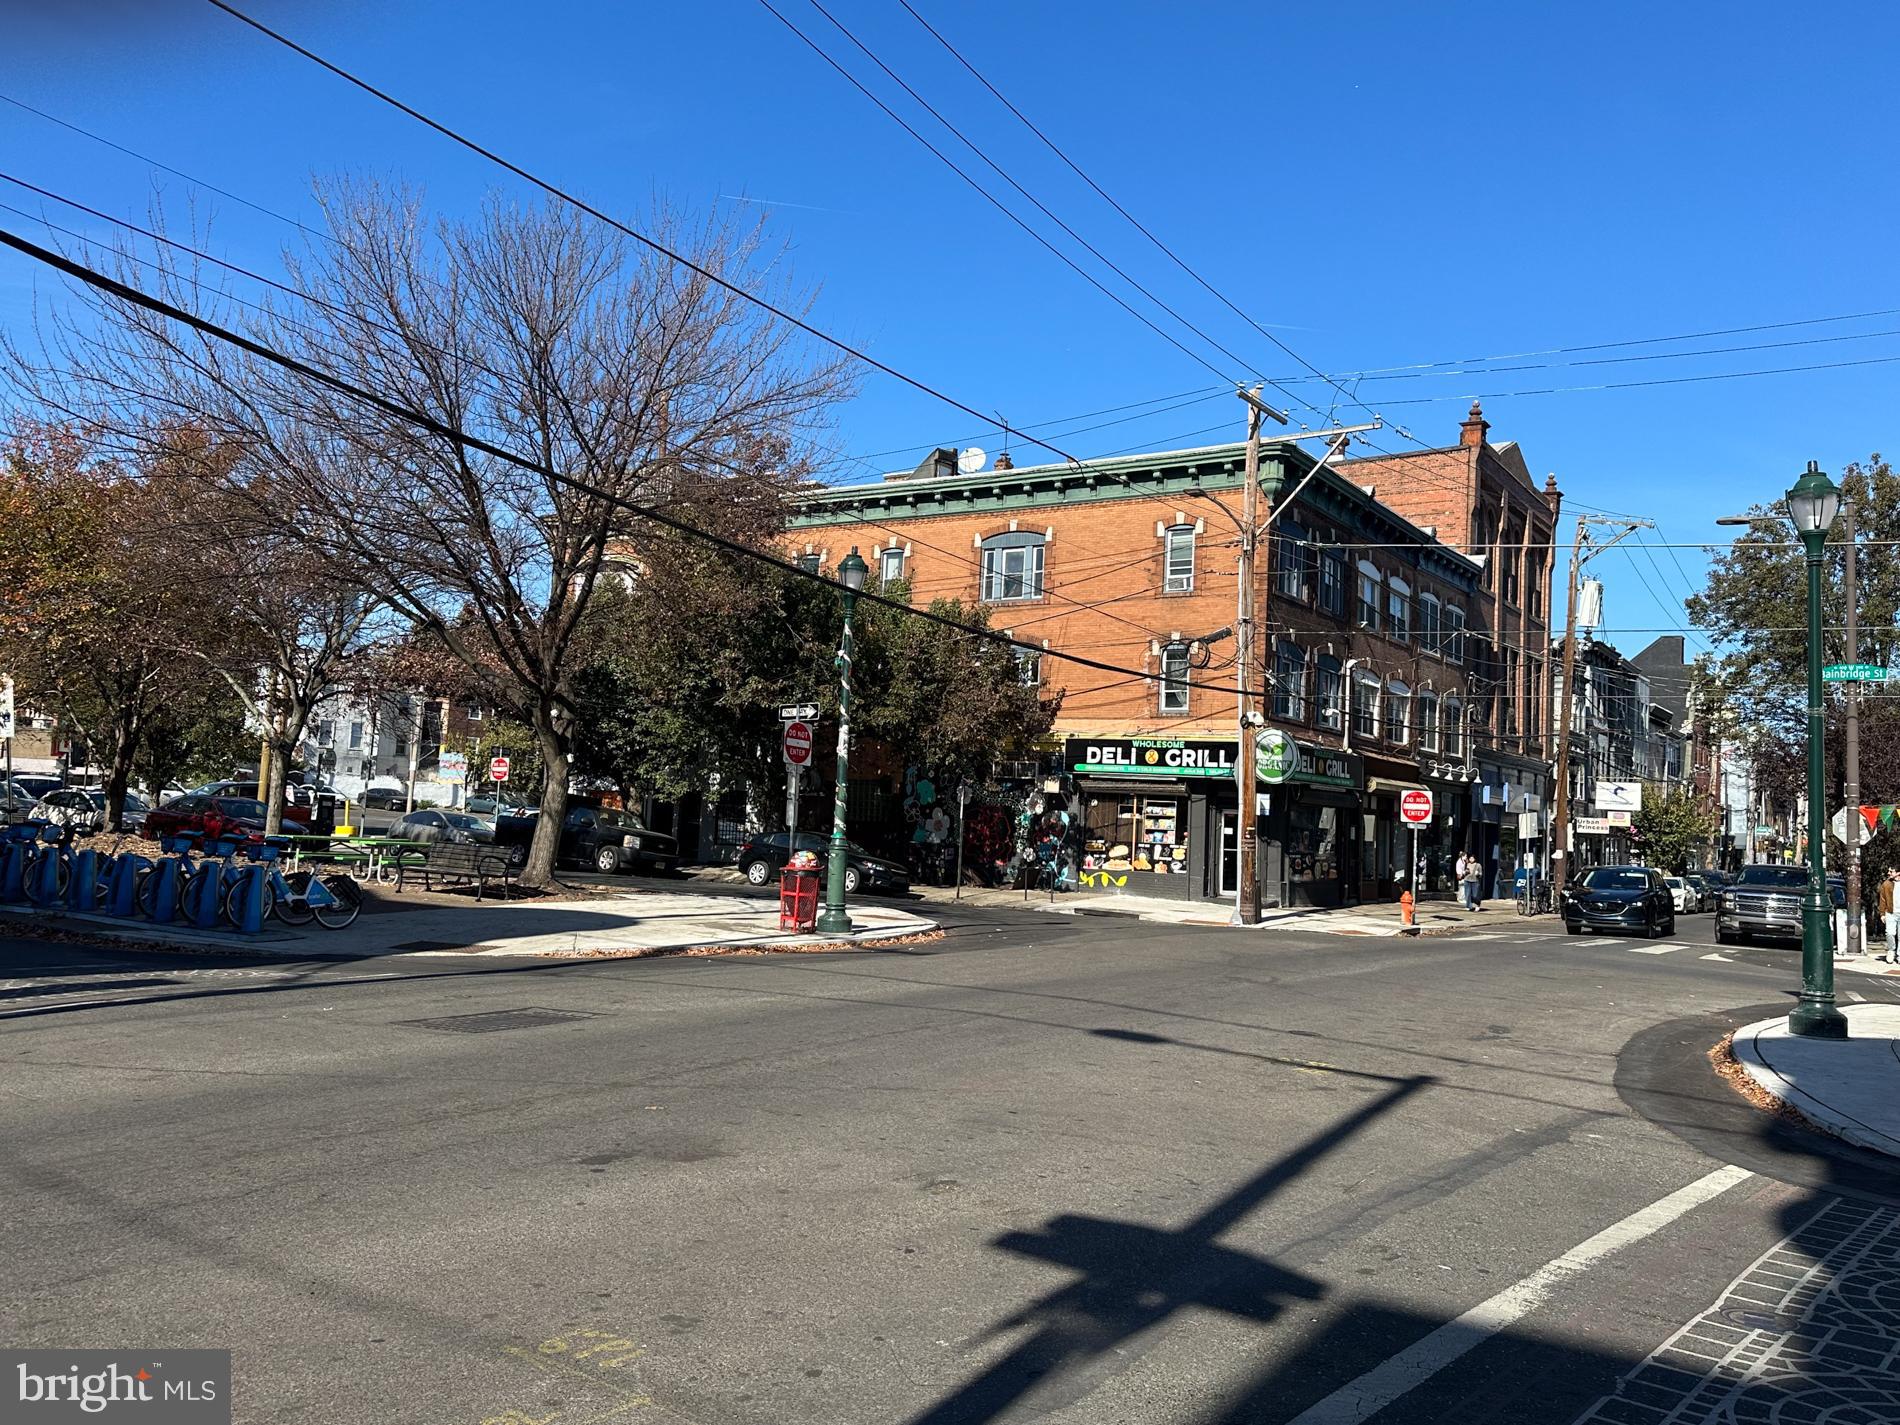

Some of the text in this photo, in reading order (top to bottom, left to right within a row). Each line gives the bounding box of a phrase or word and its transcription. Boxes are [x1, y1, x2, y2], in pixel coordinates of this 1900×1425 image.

[1874, 669, 1883, 677] St
[788, 729, 808, 739] DO NOT
[1132, 740, 1185, 749] WHOLESOME
[790, 748, 805, 756] ENTER
[1086, 747, 1137, 765] DELI
[1165, 749, 1233, 768] GRILL
[1257, 758, 1291, 771] ORGANIC
[1325, 759, 1351, 779] GRILL
